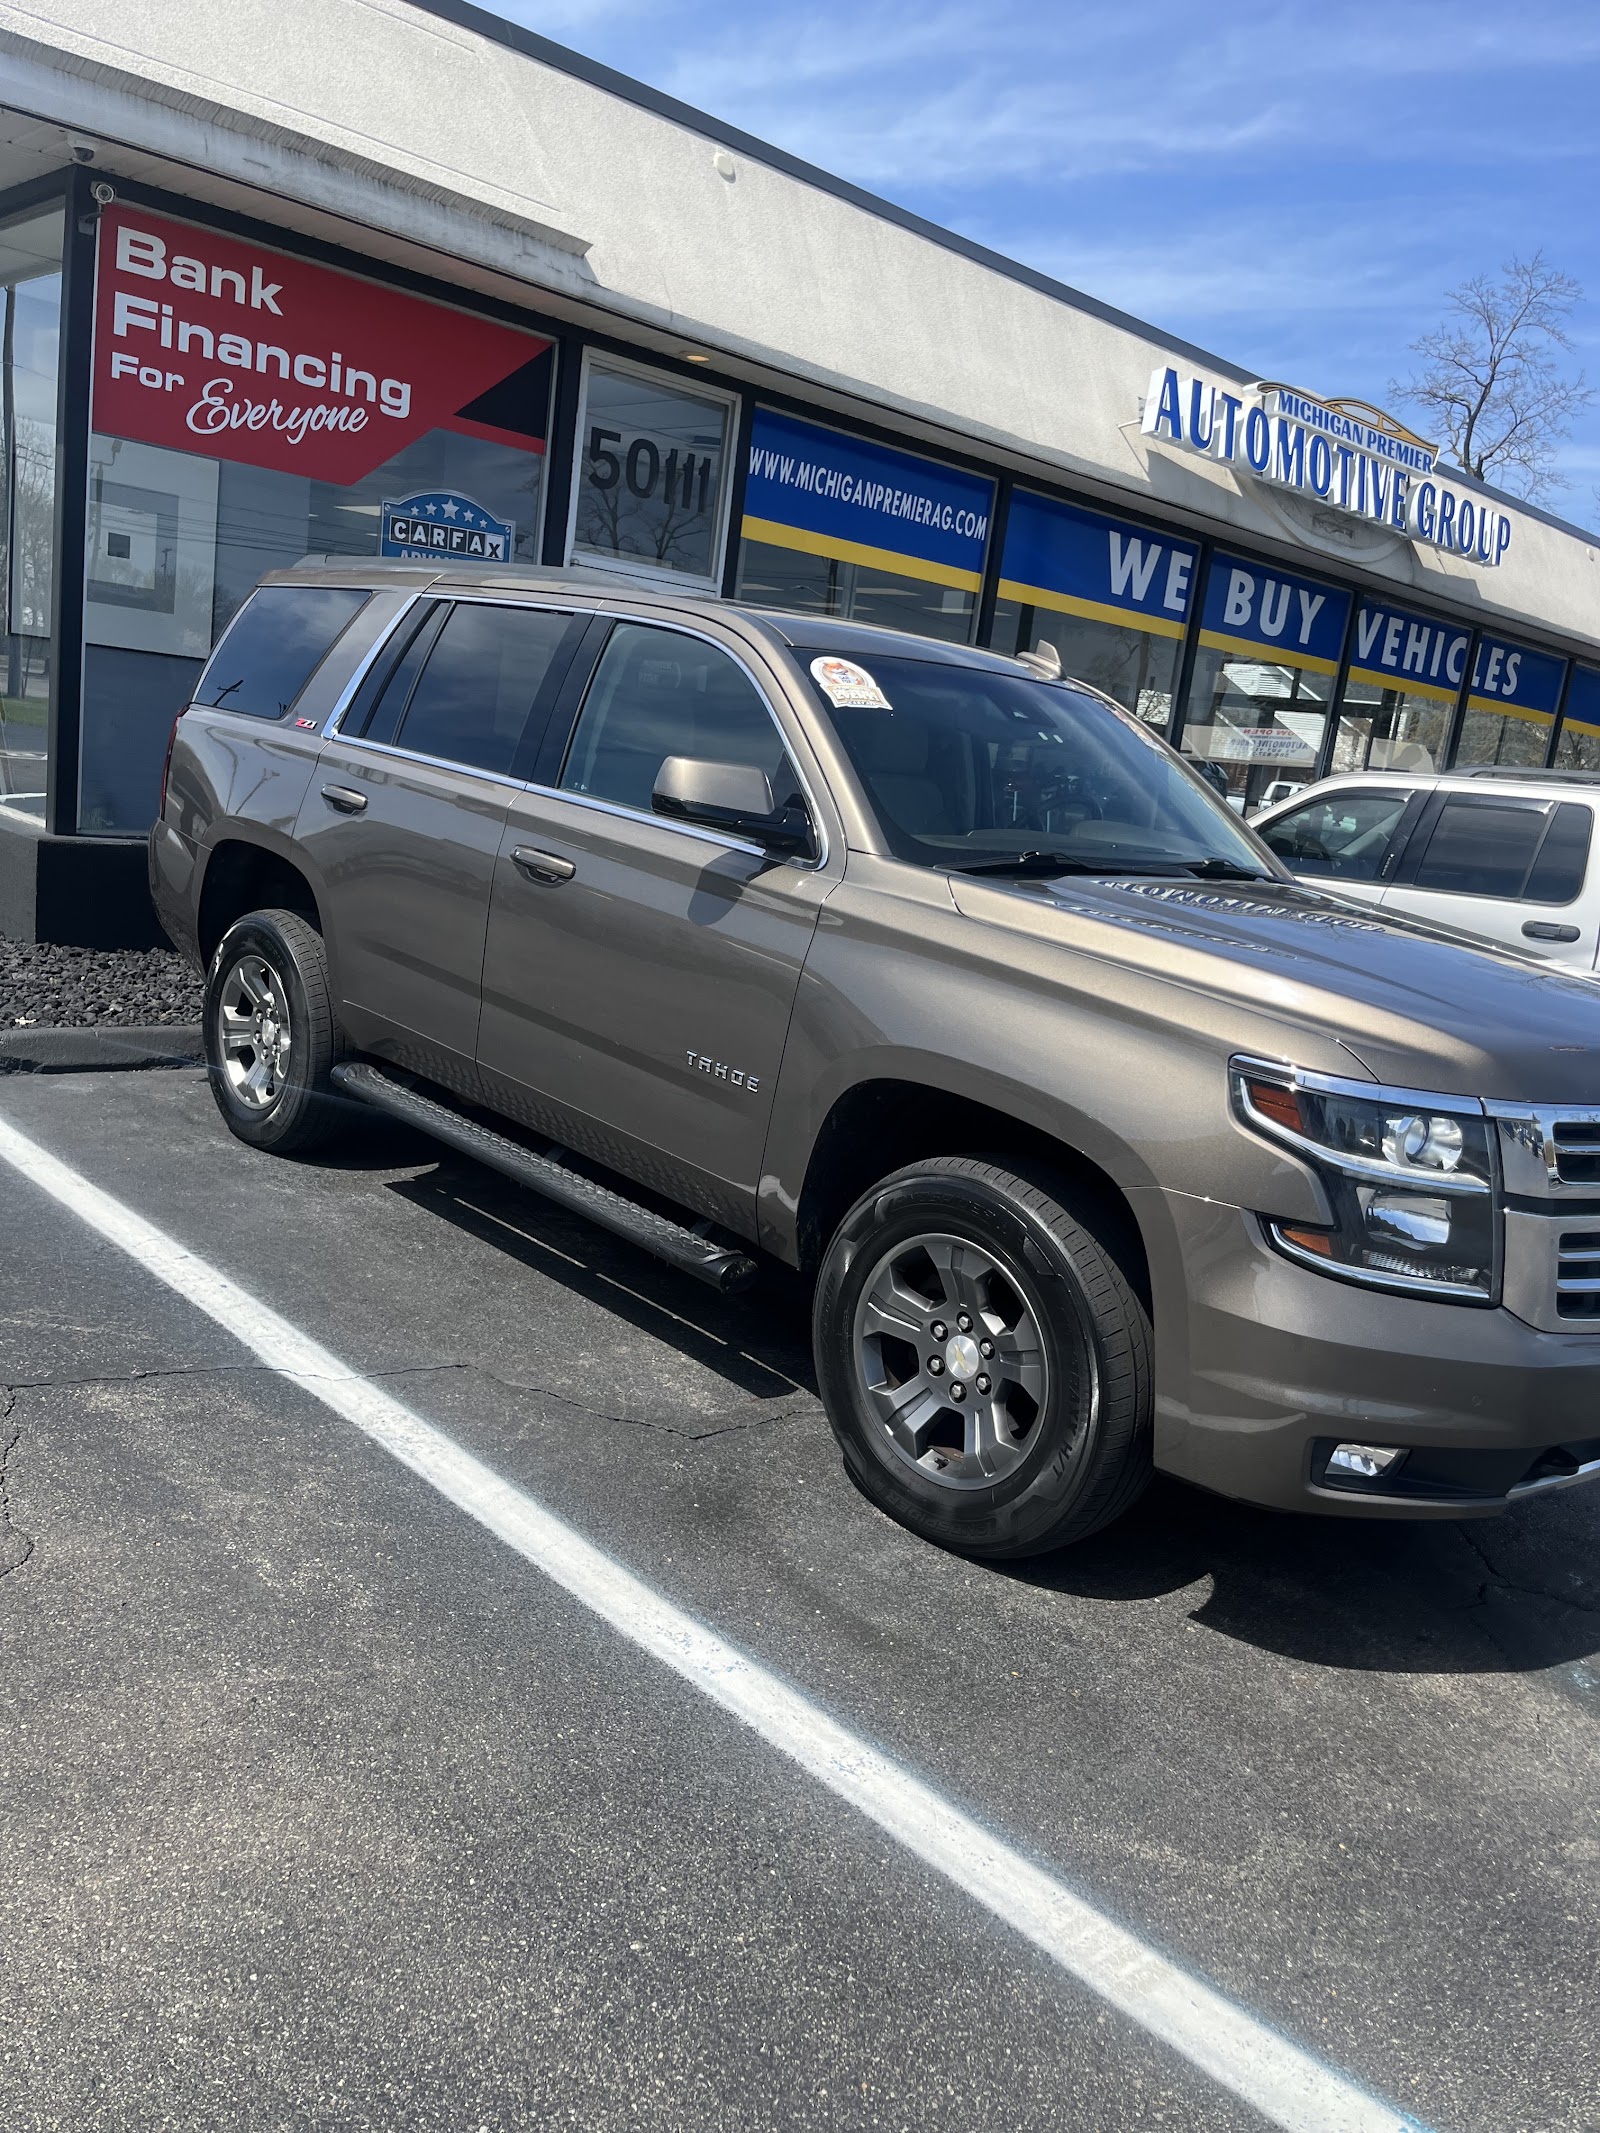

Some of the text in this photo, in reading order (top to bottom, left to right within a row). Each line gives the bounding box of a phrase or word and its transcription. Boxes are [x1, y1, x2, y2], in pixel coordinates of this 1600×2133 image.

[116, 225, 284, 316] Bank
[111, 351, 369, 444] For Everyone
[113, 291, 411, 418] Financing
[588, 426, 712, 513] 50111
[1150, 366, 1511, 567] AUTOMOTIVE GROUP
[1278, 389, 1433, 474] MICHIGAN PREMIER
[749, 446, 988, 541] WWW.MICHIGANPREMIERAG.COM
[393, 521, 502, 559] CARFAX
[1109, 530, 1522, 696] WE BUY VEHICLES
[686, 1050, 760, 1093] TAHOE
